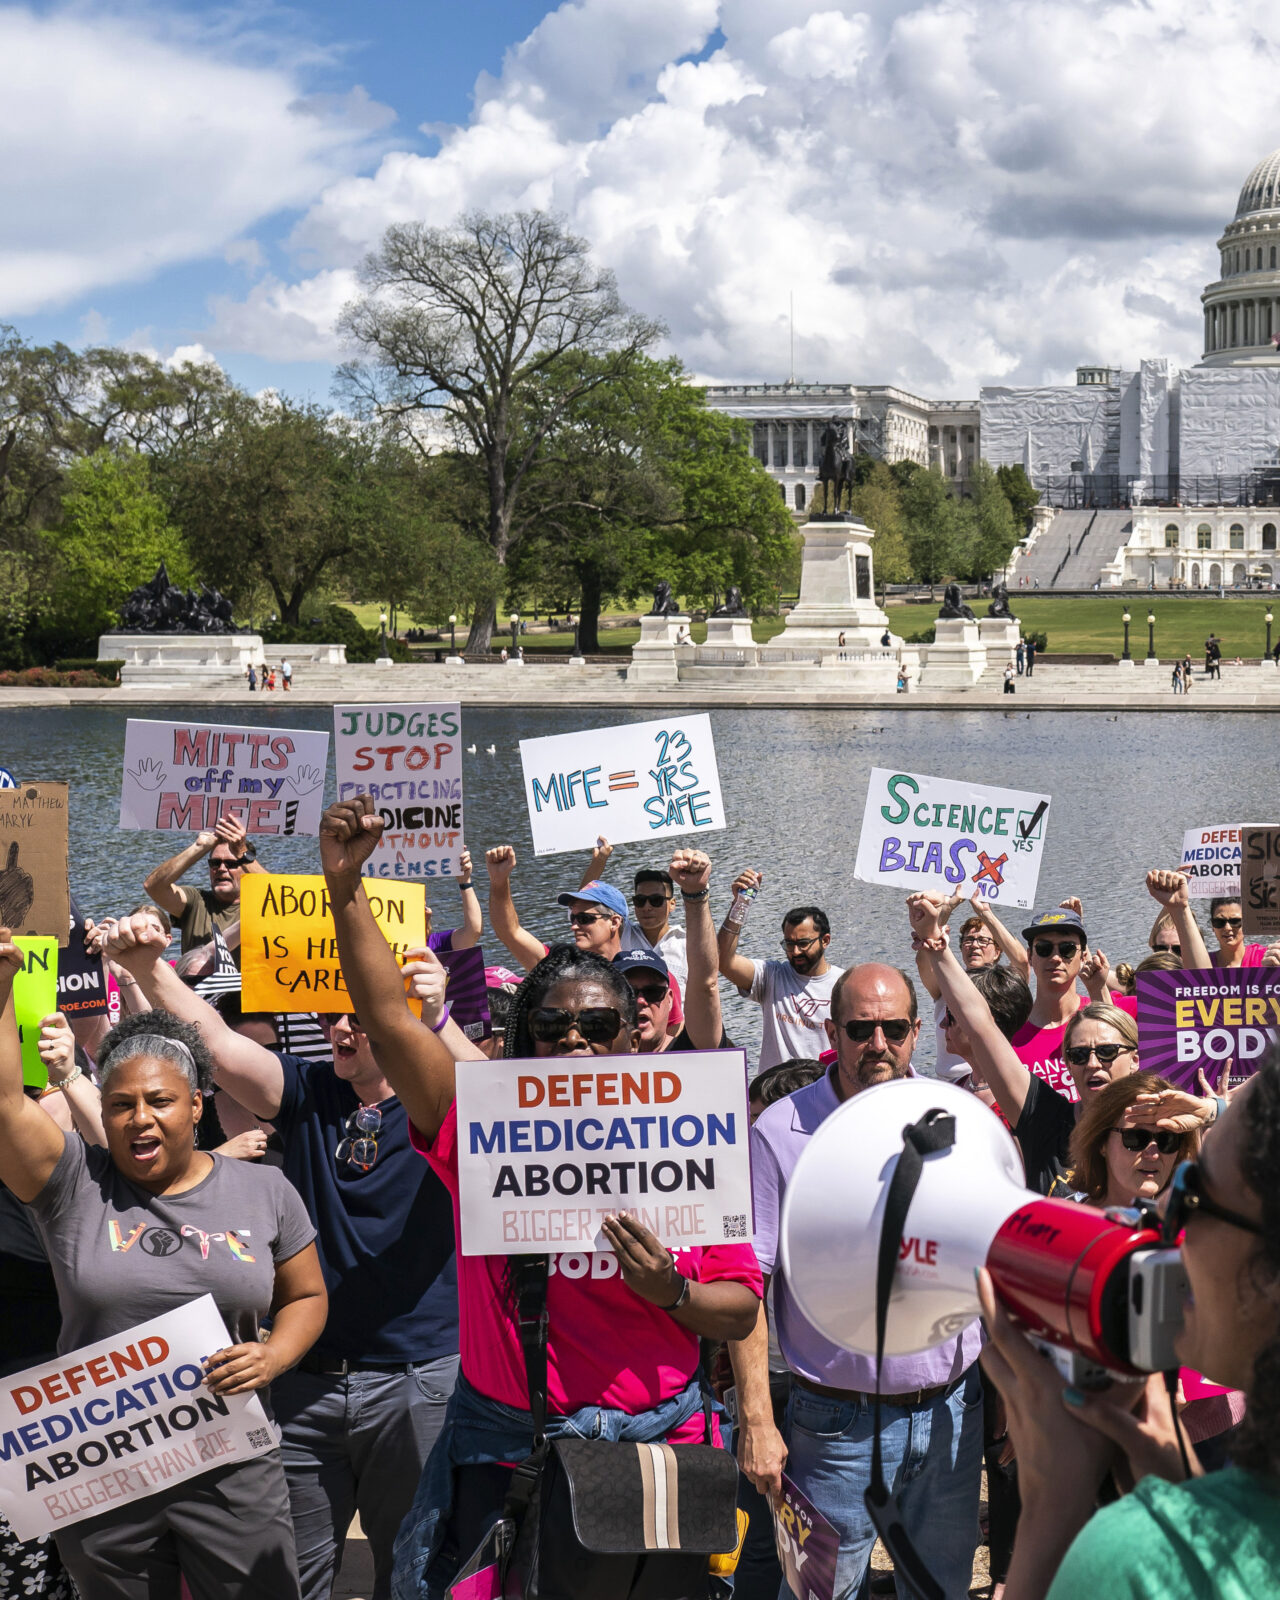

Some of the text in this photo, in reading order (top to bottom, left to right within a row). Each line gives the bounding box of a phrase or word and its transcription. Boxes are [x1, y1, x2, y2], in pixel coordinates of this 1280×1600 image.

[340, 711, 459, 738] JUDGES
[173, 729, 296, 771] MITTS
[352, 743, 454, 771] STOP
[654, 729, 693, 767] 23
[185, 768, 286, 799] off my
[532, 766, 609, 813] MIFE
[648, 761, 699, 797] YRS
[378, 804, 462, 831] DICINE
[643, 790, 713, 829] SAFE
[378, 832, 461, 849] ITHOUT
[1012, 839, 1034, 853] YES
[1183, 846, 1242, 862] MEDICA
[1201, 829, 1242, 845] DEFE
[878, 837, 978, 884] BIAS
[1190, 863, 1241, 877] ABORT
[261, 883, 405, 924] ABORON
[978, 881, 1000, 899] NO
[262, 936, 289, 959] IS
[1175, 984, 1241, 998] FREEDOM
[1246, 984, 1260, 995] IS
[517, 1071, 682, 1109] DEFEND
[469, 1112, 737, 1155] MEDICATION
[491, 1158, 716, 1198] ABORTION
[502, 1208, 592, 1243] BIGGER
[665, 1204, 706, 1237] ROE
[898, 1236, 939, 1266] YLE
[9, 1335, 171, 1416] DEFEND
[25, 1393, 231, 1492] ABORTION
[43, 1427, 237, 1521] BIGGER THAN ROE
